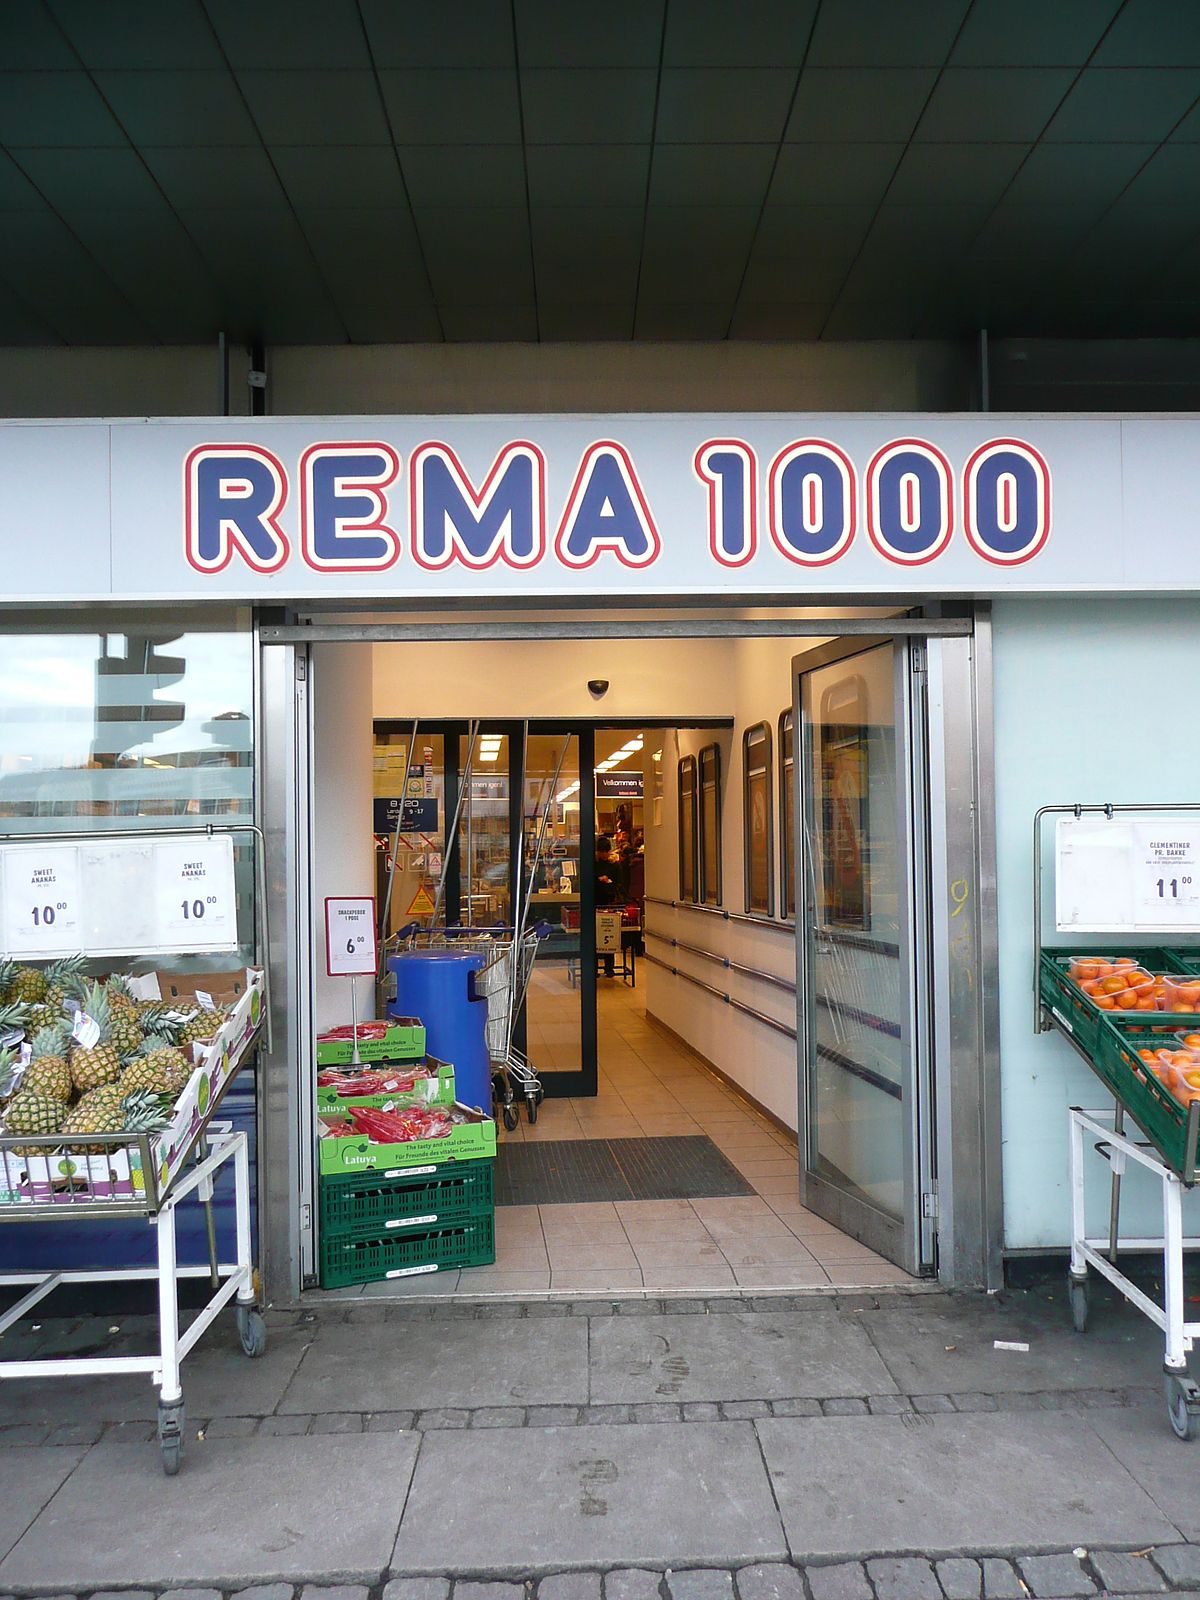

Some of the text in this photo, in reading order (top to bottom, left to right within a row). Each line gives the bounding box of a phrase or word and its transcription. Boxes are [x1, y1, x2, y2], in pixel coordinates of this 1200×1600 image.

[184, 437, 1053, 575] REMA 1000
[184, 862, 203, 870] SWEET
[33, 868, 53, 876] SWEET
[181, 869, 206, 877] ANANAS
[346, 938, 355, 954] 6
[317, 1105, 347, 1113] Latuya
[406, 1151, 429, 1159] Freunde
[460, 1145, 486, 1153] Genusses
[345, 1154, 377, 1166] Latuya
